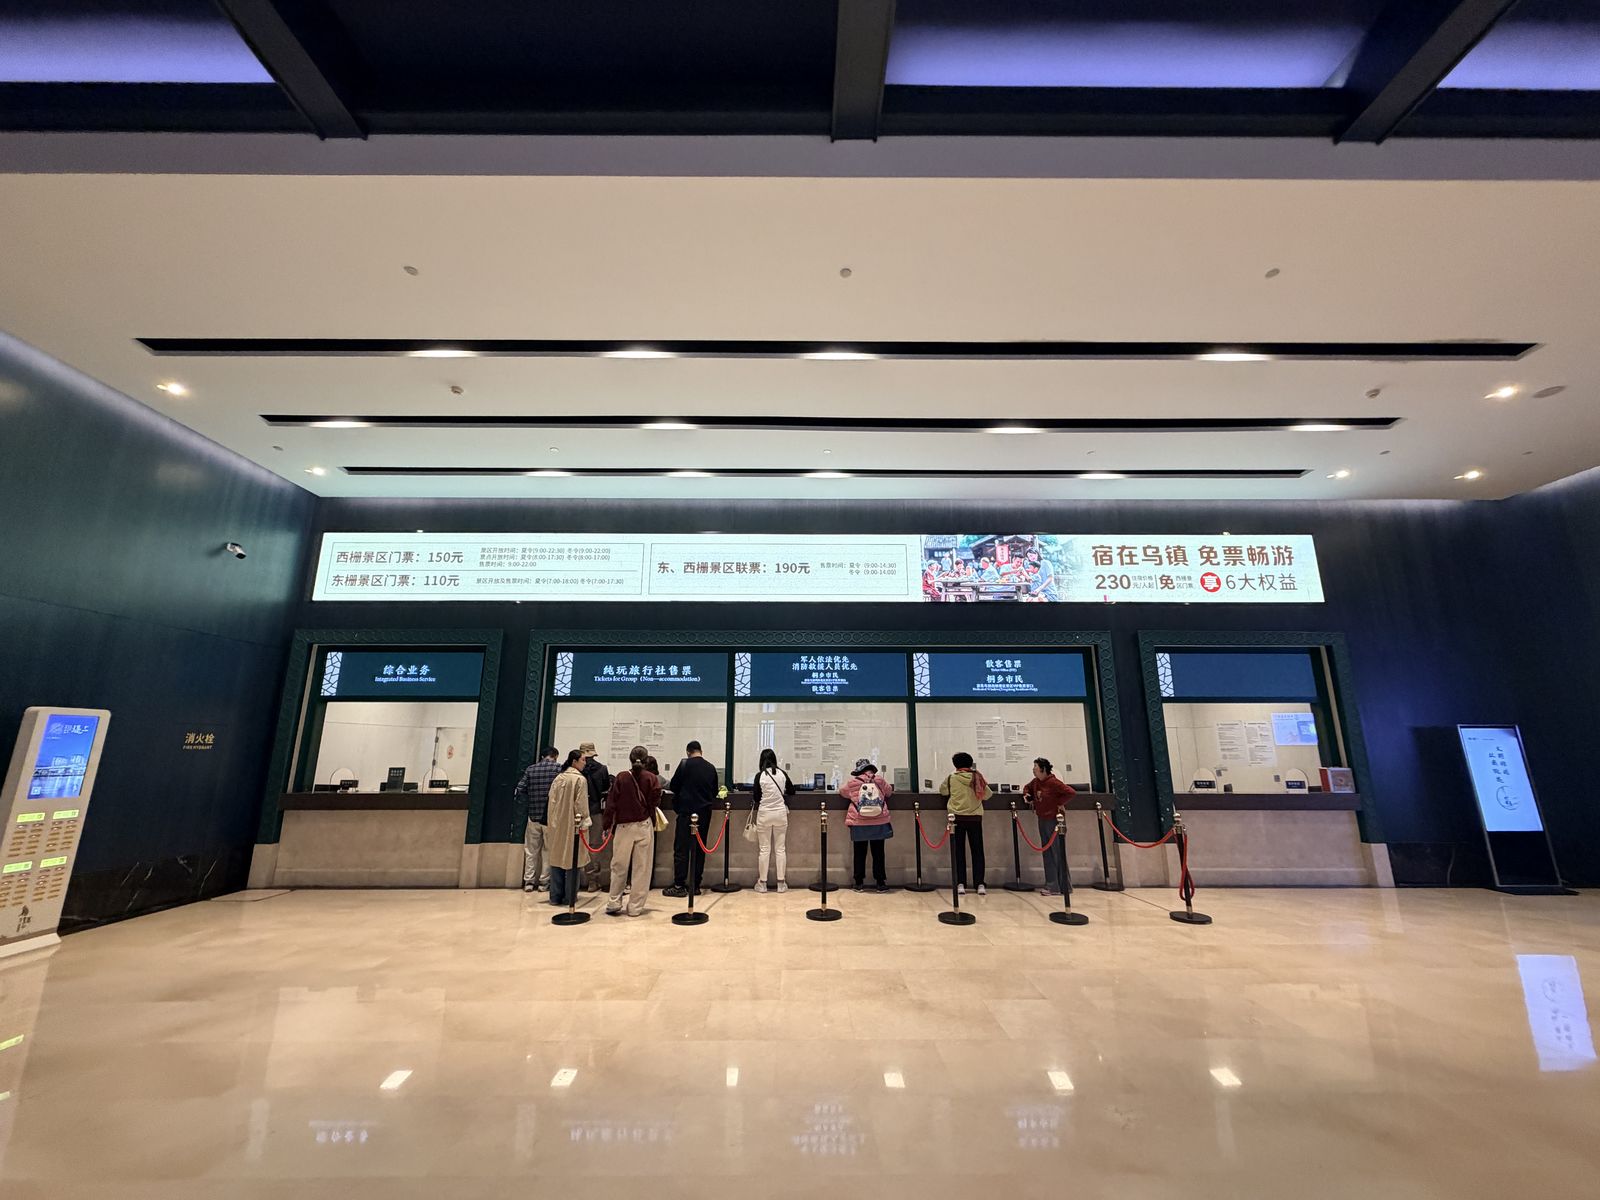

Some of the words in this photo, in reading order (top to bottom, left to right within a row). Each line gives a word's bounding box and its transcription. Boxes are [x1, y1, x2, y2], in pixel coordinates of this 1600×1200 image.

[335, 551, 464, 564] 西栅景区门票：150元
[1092, 545, 1189, 566] 宿在乌镇
[1198, 545, 1295, 567] 免票畅游
[657, 561, 811, 574] 东、西栅景区联票：190元
[331, 574, 460, 588] 东栅景区门票：110元
[1095, 574, 1132, 590] 230
[1159, 574, 1176, 590] 免
[1203, 576, 1220, 590] 享
[1226, 573, 1298, 591] 6大权益
[383, 664, 431, 676] 综合业务
[603, 665, 692, 676] 纯玩旅行社售票
[184, 732, 215, 744] 消火栓
